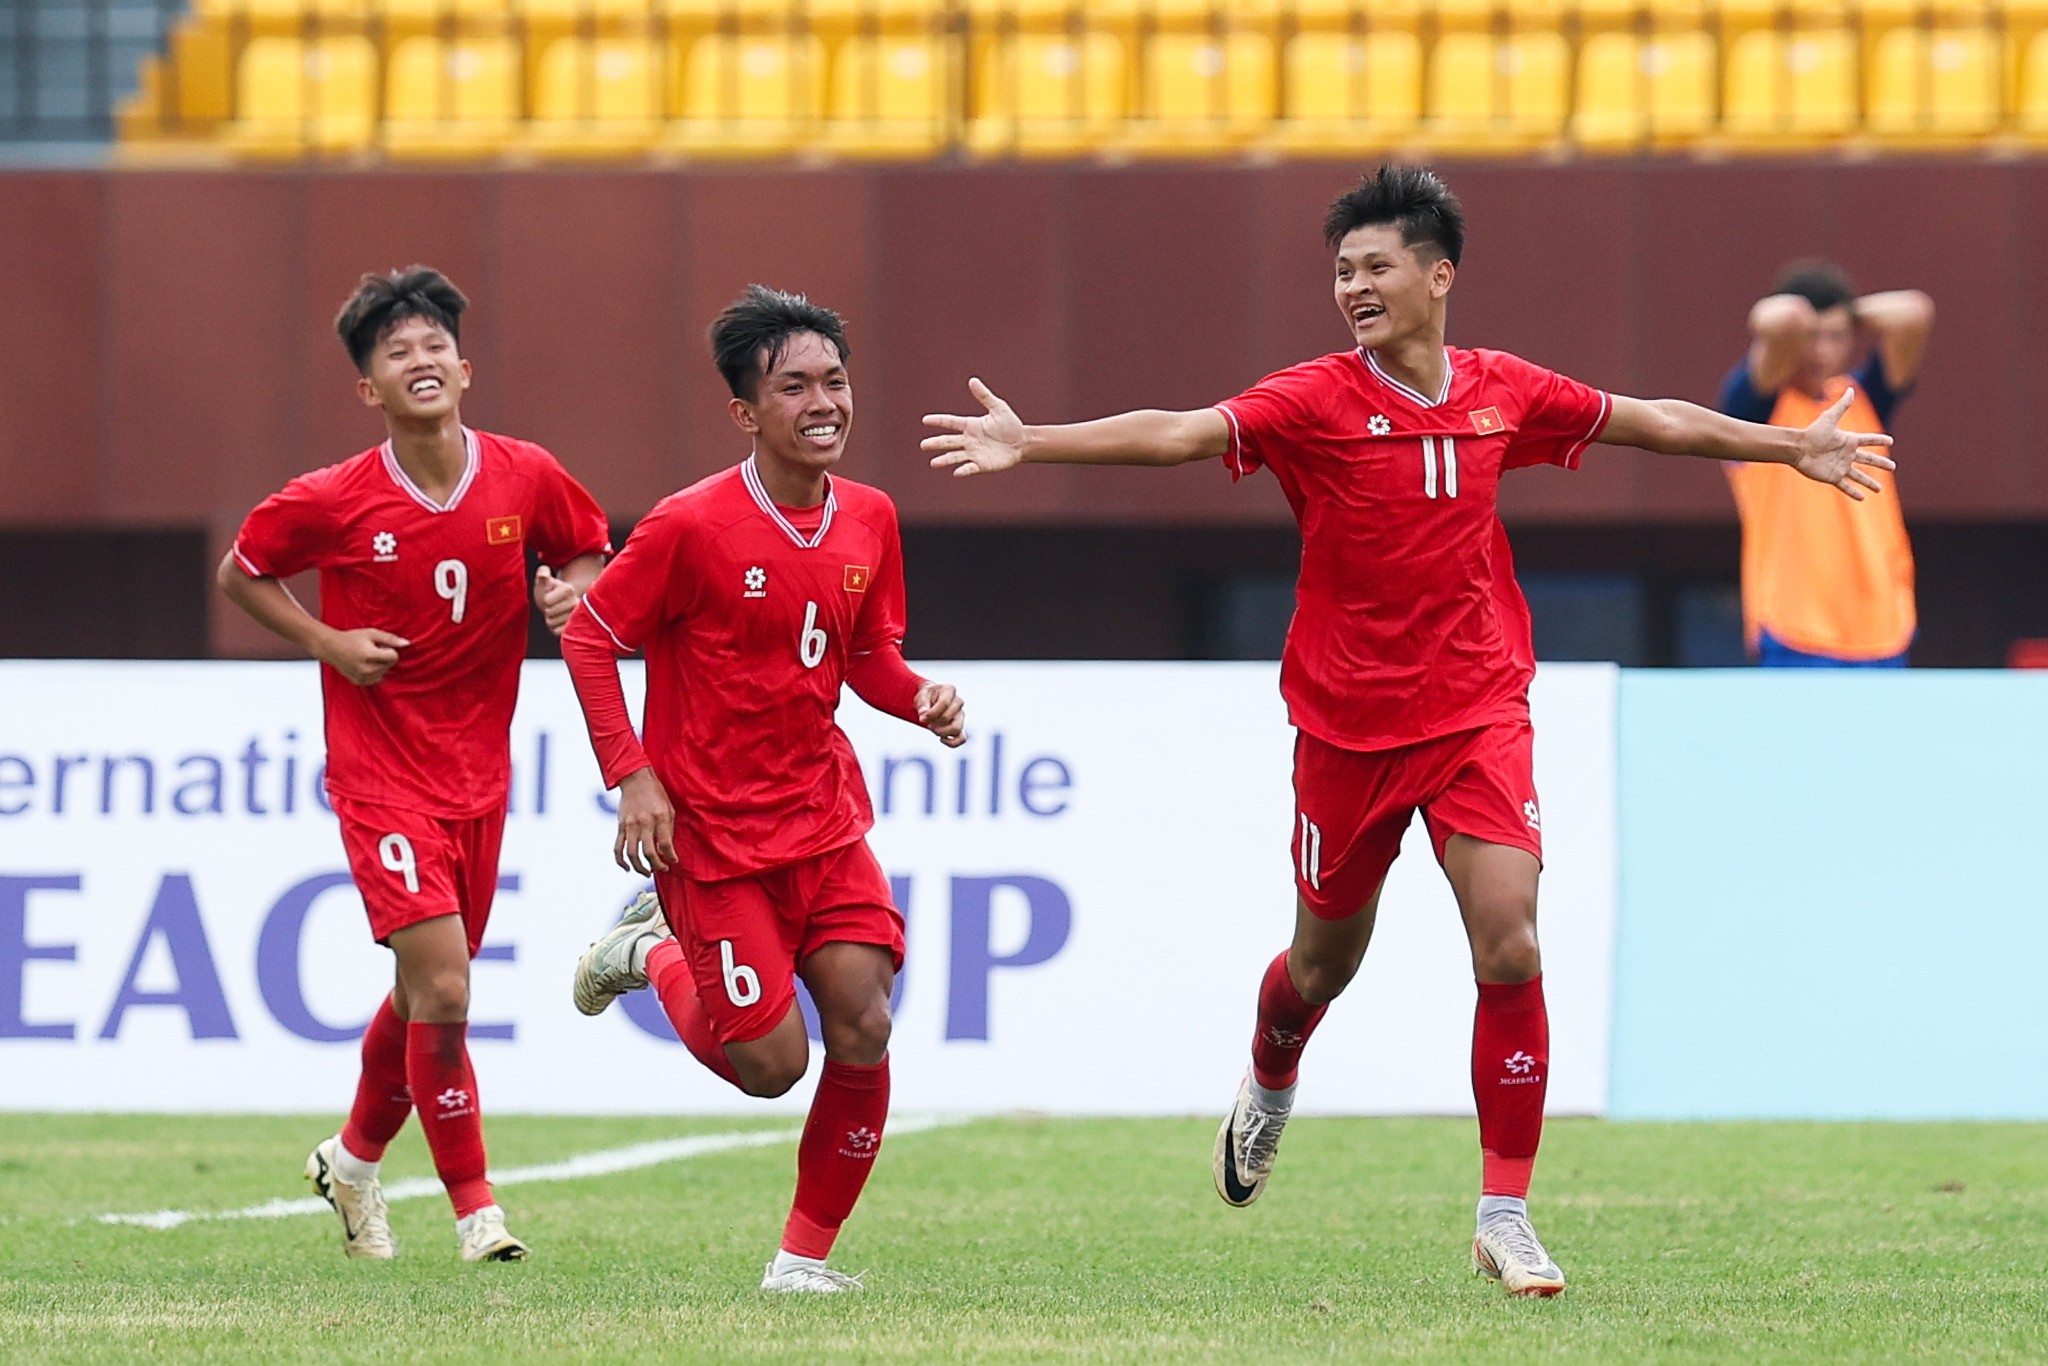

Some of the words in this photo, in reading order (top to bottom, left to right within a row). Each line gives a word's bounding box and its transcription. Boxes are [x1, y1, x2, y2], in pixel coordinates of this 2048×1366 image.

[1421, 436, 1458, 499] 11
[434, 559, 468, 624] 9
[800, 600, 827, 669] 6
[0, 733, 549, 816] ernatil
[378, 833, 421, 894] 9
[1300, 812, 1321, 891] 11
[719, 938, 761, 1007] 6
